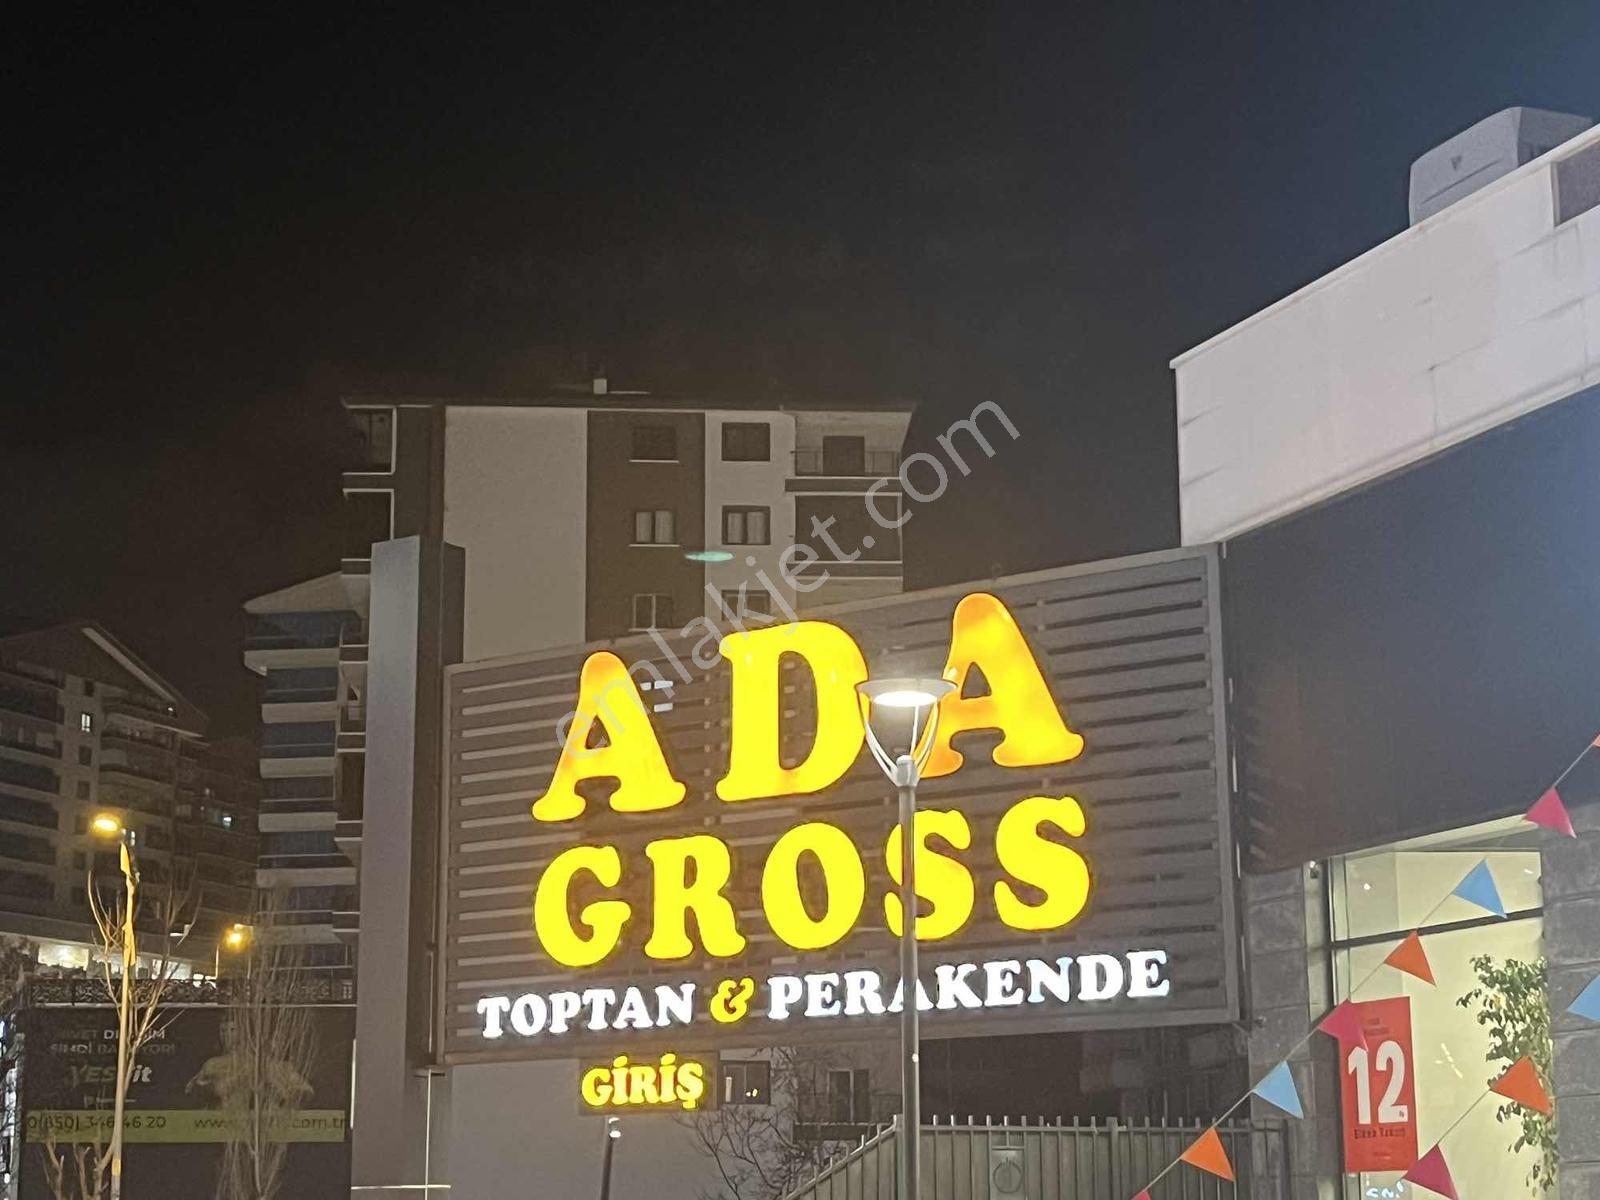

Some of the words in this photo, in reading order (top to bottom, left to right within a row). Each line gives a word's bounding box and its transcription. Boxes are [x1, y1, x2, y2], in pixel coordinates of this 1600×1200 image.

[532, 592, 1084, 822] ADA
[533, 796, 1091, 968] GROSS
[477, 983, 696, 1039] TOPTAN
[710, 977, 755, 1023] &
[767, 950, 1170, 1020] PERAKENDE
[146, 1115, 167, 1129] 20
[581, 1053, 704, 1109] GİRİŞ
[1347, 1040, 1409, 1125] 12
